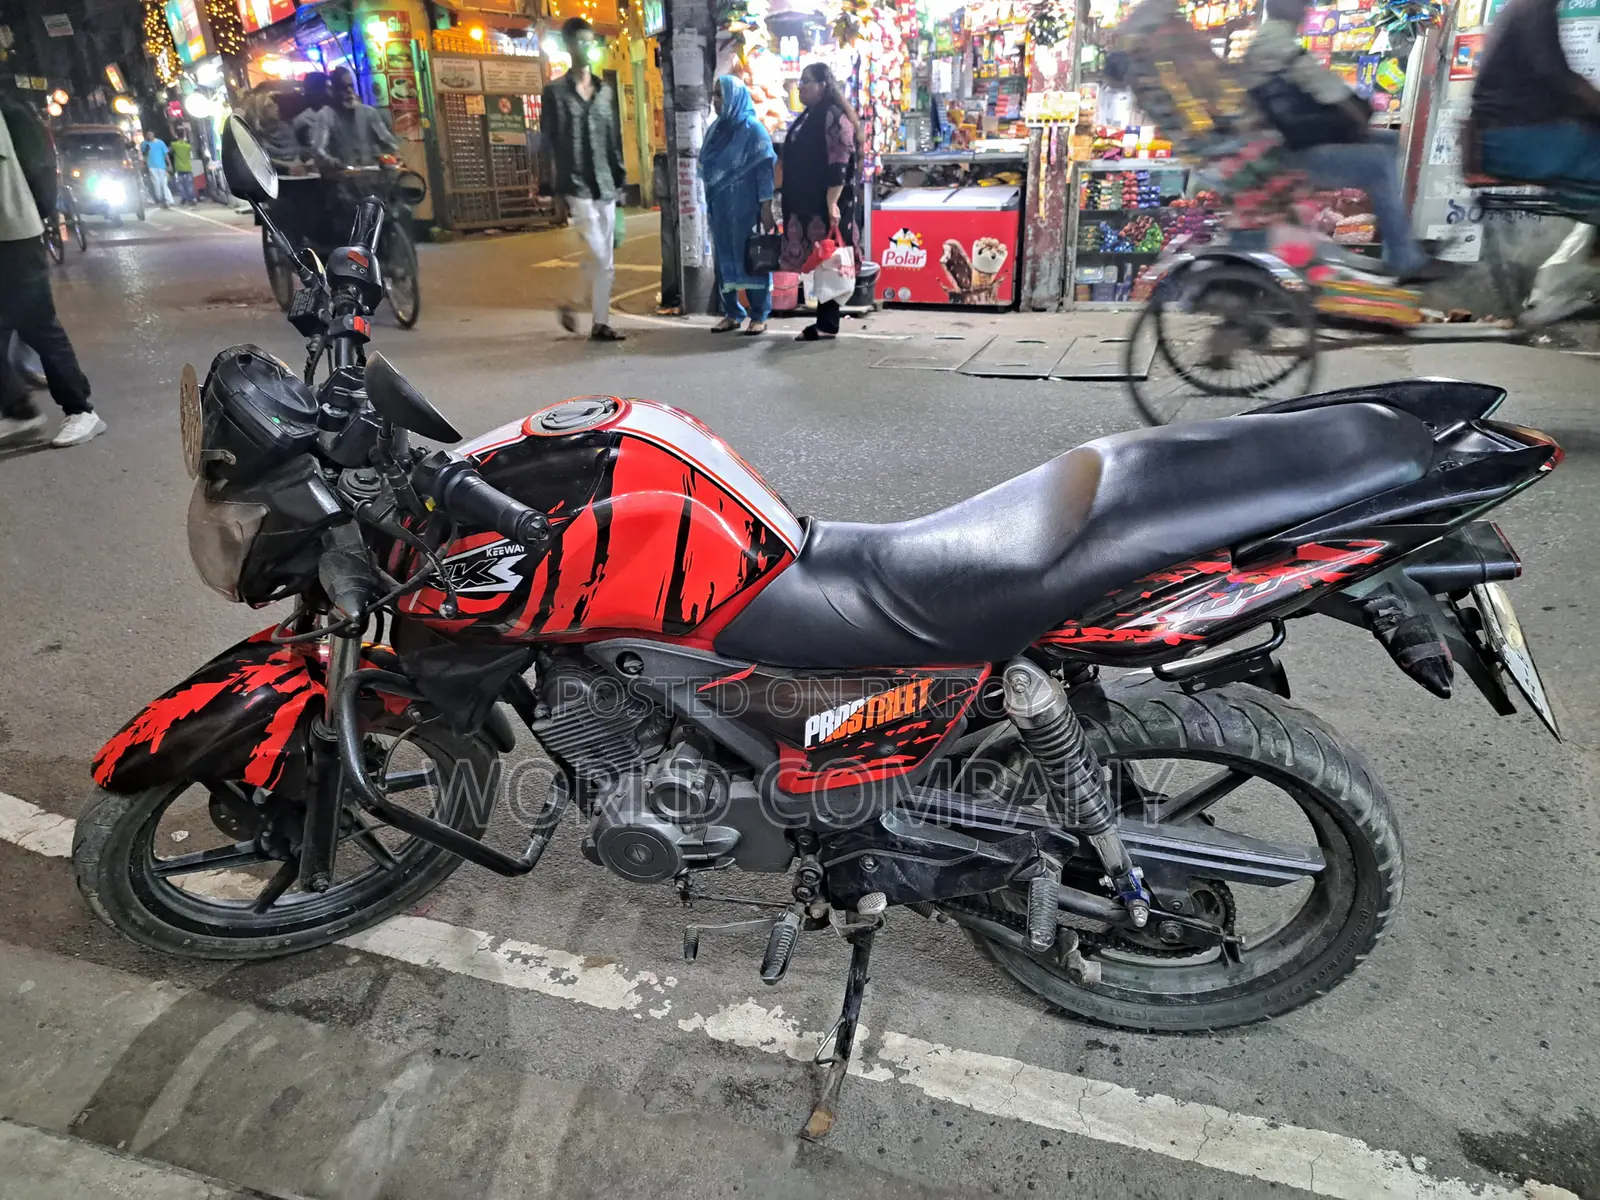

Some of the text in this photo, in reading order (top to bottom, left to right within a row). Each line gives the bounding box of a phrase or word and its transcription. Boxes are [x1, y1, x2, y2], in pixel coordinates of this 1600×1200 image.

[885, 251, 924, 265] Polar
[486, 544, 525, 558] KEEWAY
[804, 677, 934, 748] PROSTREET
